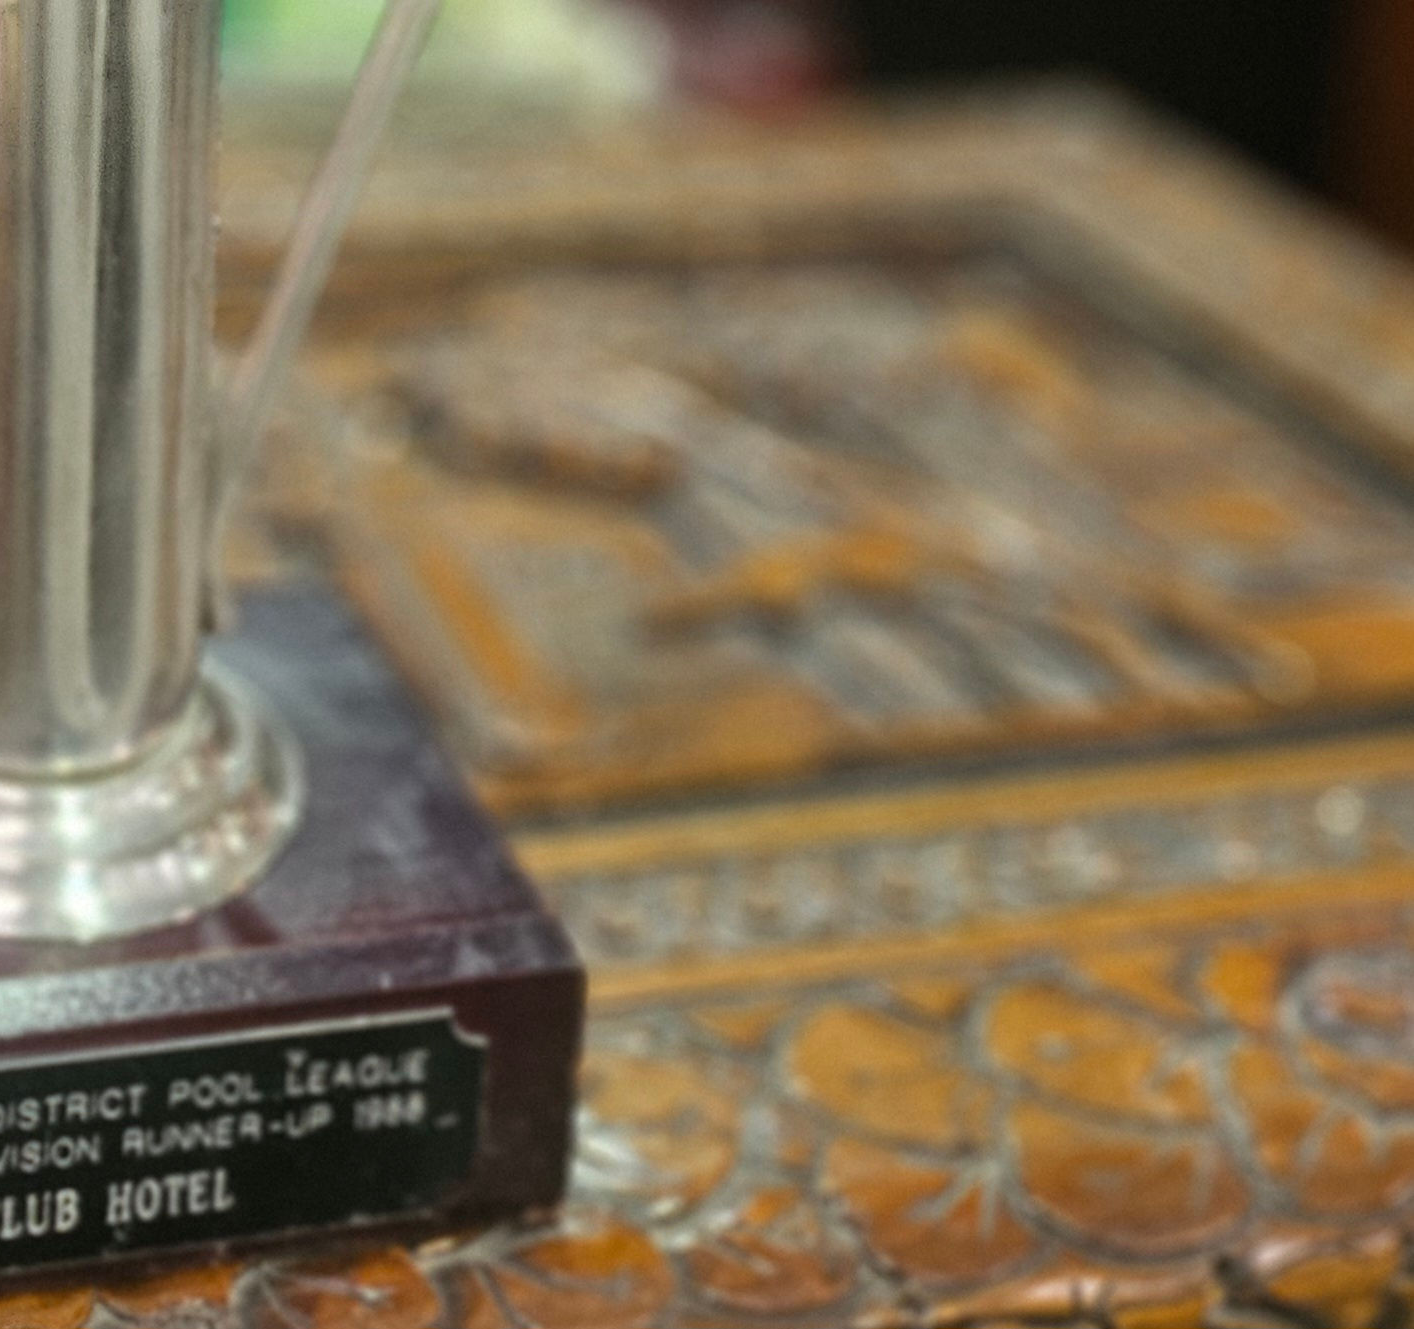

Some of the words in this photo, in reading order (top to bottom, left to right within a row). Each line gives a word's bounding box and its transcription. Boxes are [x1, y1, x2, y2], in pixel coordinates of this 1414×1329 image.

[168, 1072, 263, 1109] POOL
[285, 1049, 429, 1096] LEAGUE
[122, 1102, 333, 1156] RUNNER-UP
[106, 1167, 235, 1225] HOTEL
